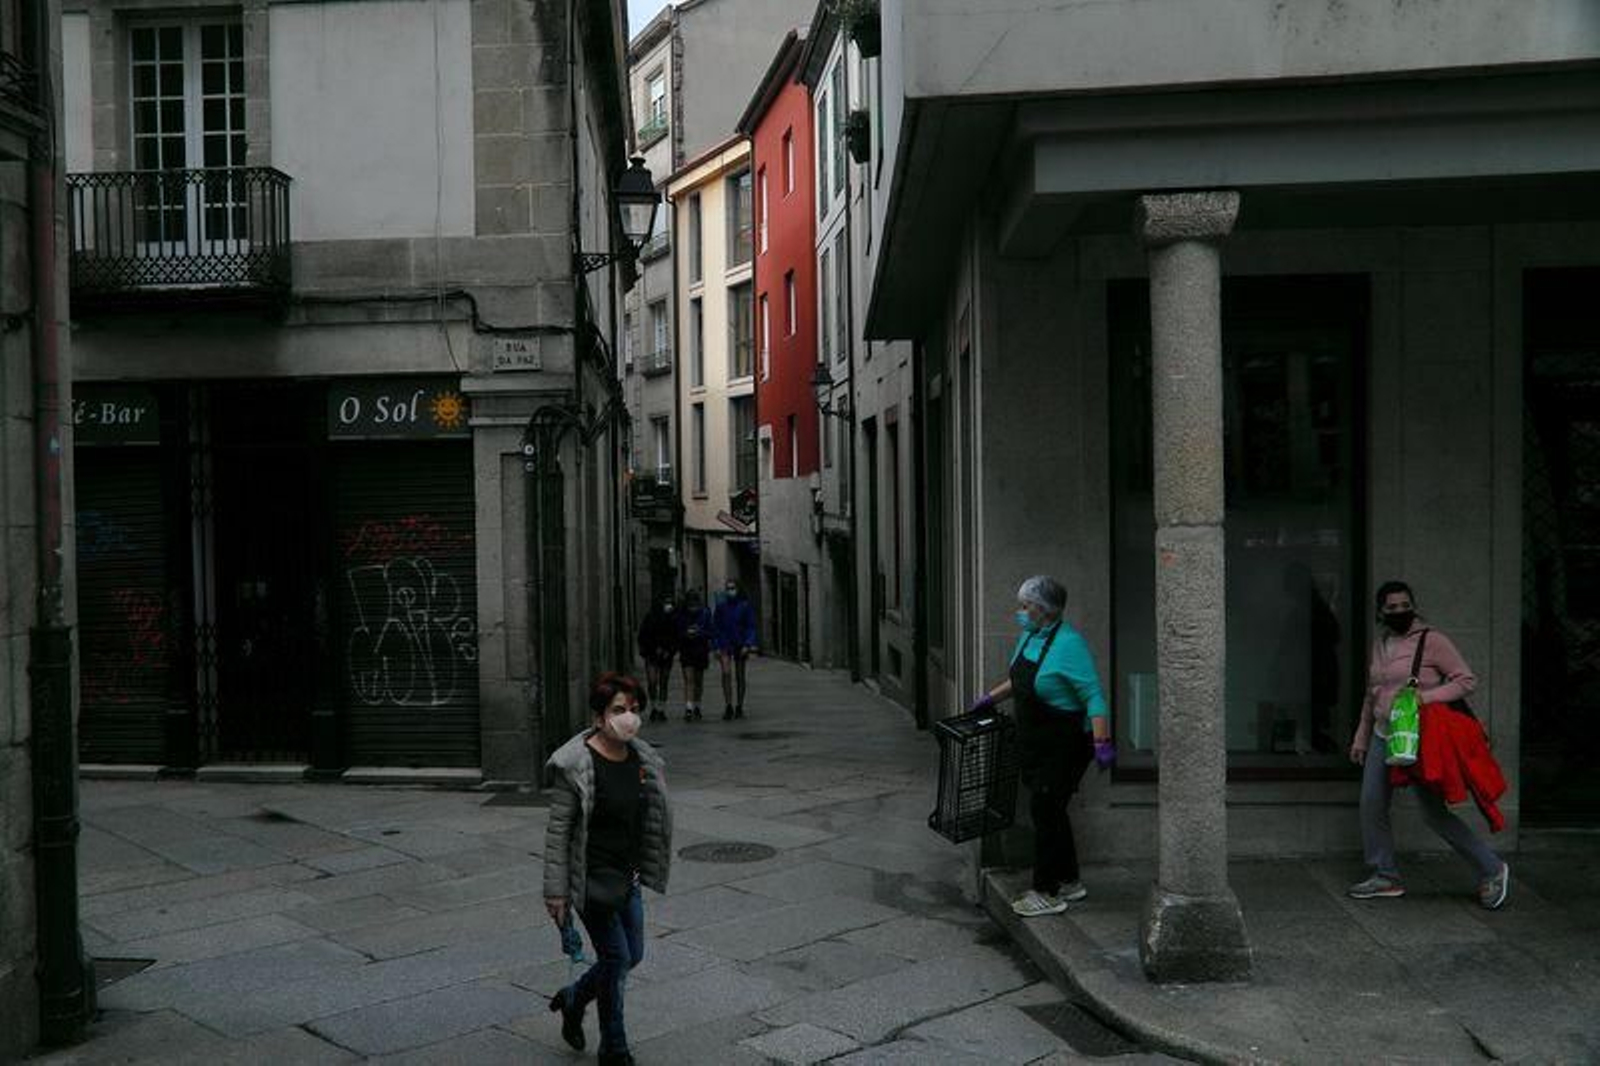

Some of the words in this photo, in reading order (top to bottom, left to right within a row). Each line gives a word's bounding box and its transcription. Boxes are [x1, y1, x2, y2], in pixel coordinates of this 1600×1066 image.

[73, 398, 145, 425] é-Bar
[339, 396, 360, 425] O
[374, 388, 425, 423] Sol
